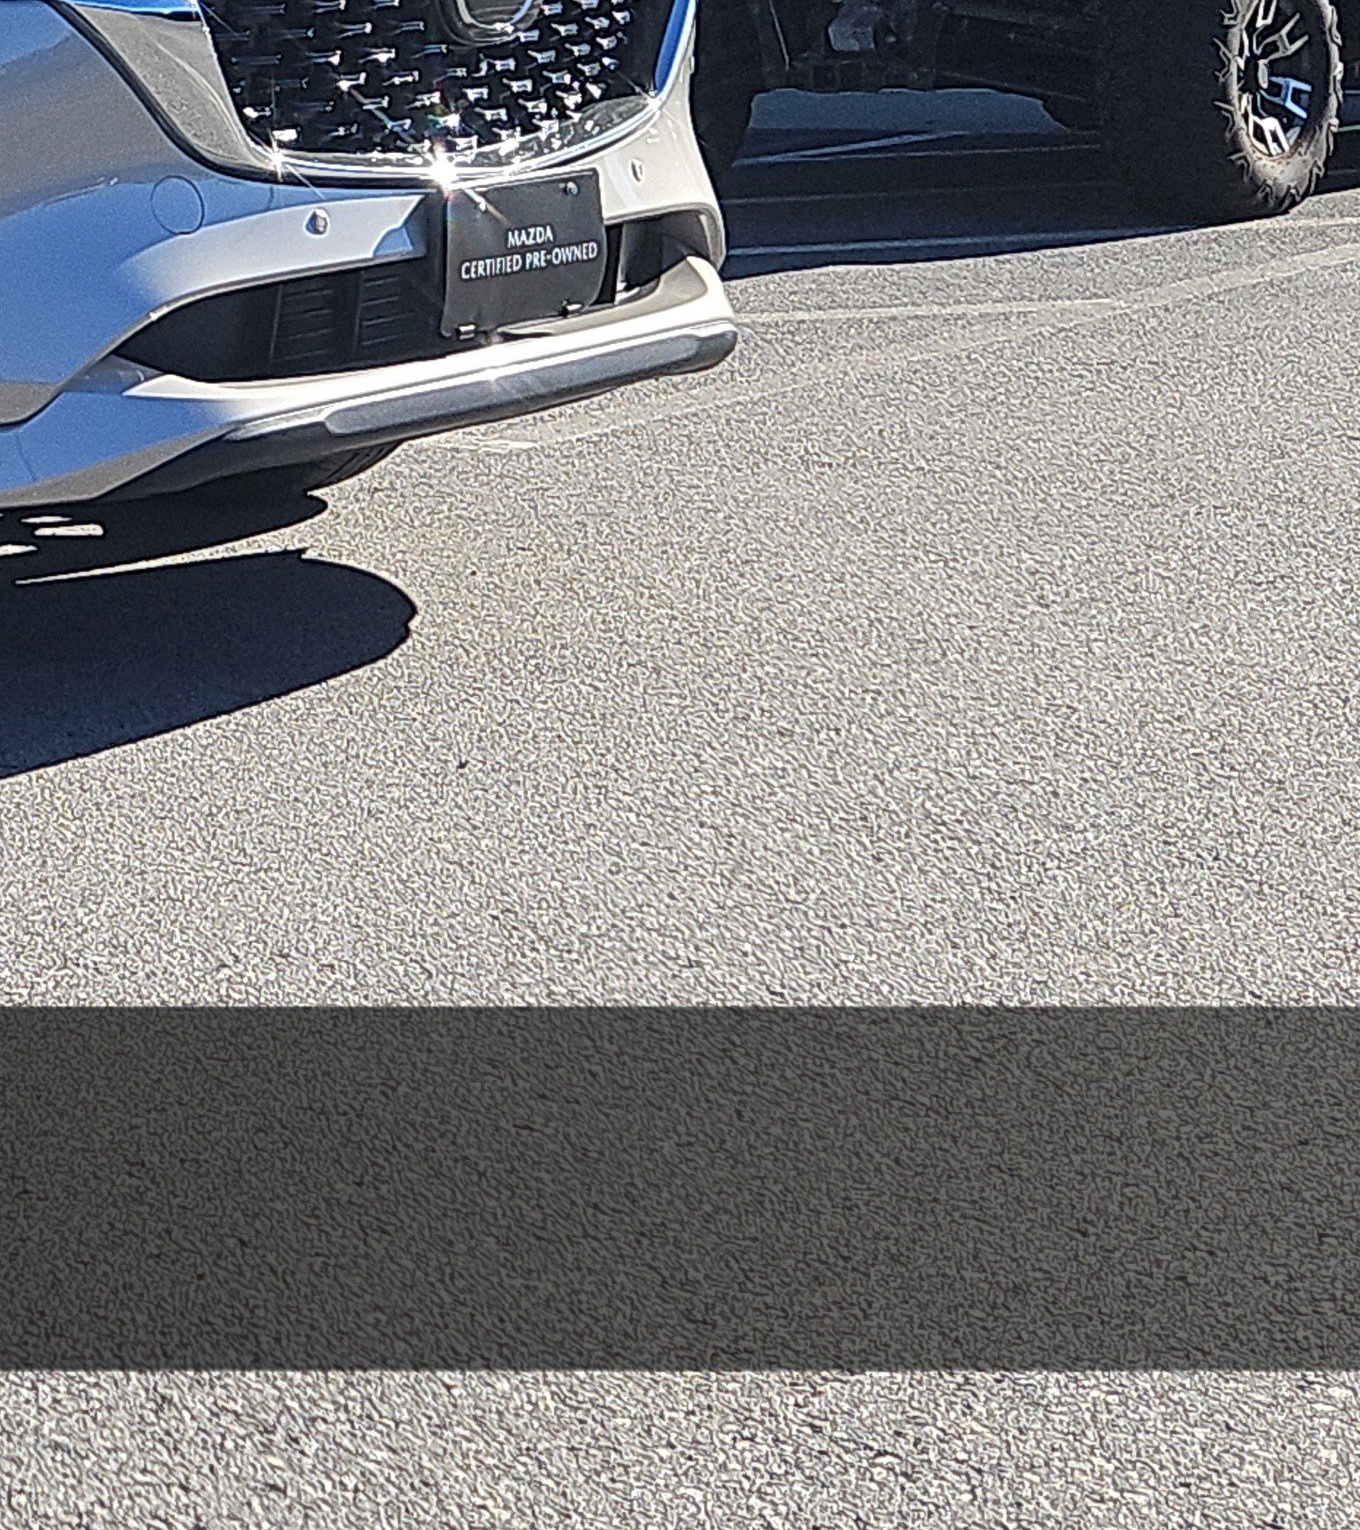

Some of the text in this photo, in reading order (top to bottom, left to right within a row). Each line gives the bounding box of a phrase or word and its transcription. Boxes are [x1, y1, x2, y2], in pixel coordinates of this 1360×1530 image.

[506, 225, 554, 248] MAZDA
[460, 241, 599, 280] CERTIFIED PRE-OWNED
